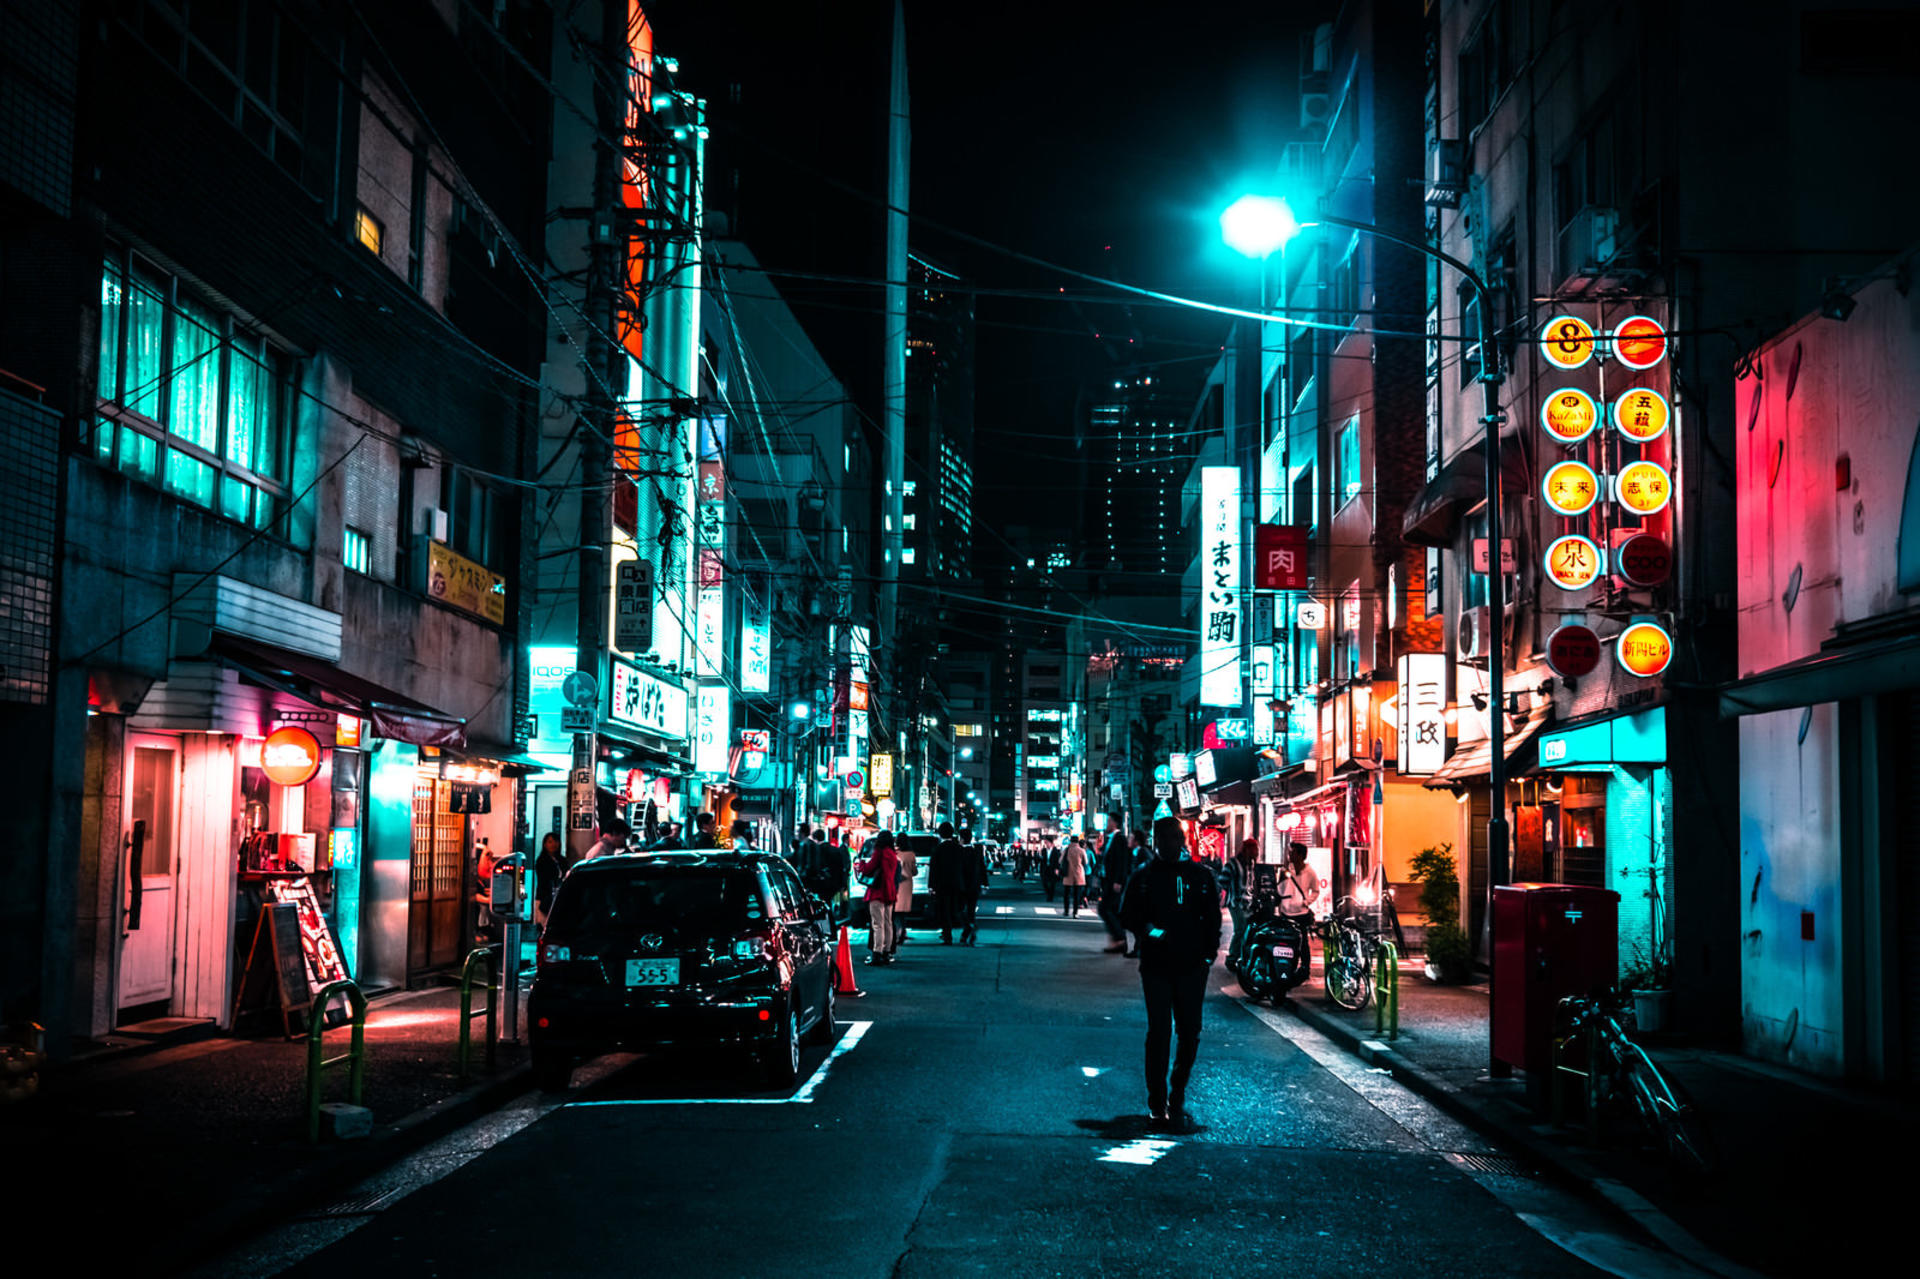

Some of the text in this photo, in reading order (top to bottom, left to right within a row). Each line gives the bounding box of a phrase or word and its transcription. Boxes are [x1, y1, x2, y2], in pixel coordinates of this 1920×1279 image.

[1207, 540, 1237, 644] まとい駒
[1268, 548, 1295, 574] 肉
[1415, 682, 1440, 745] 三政
